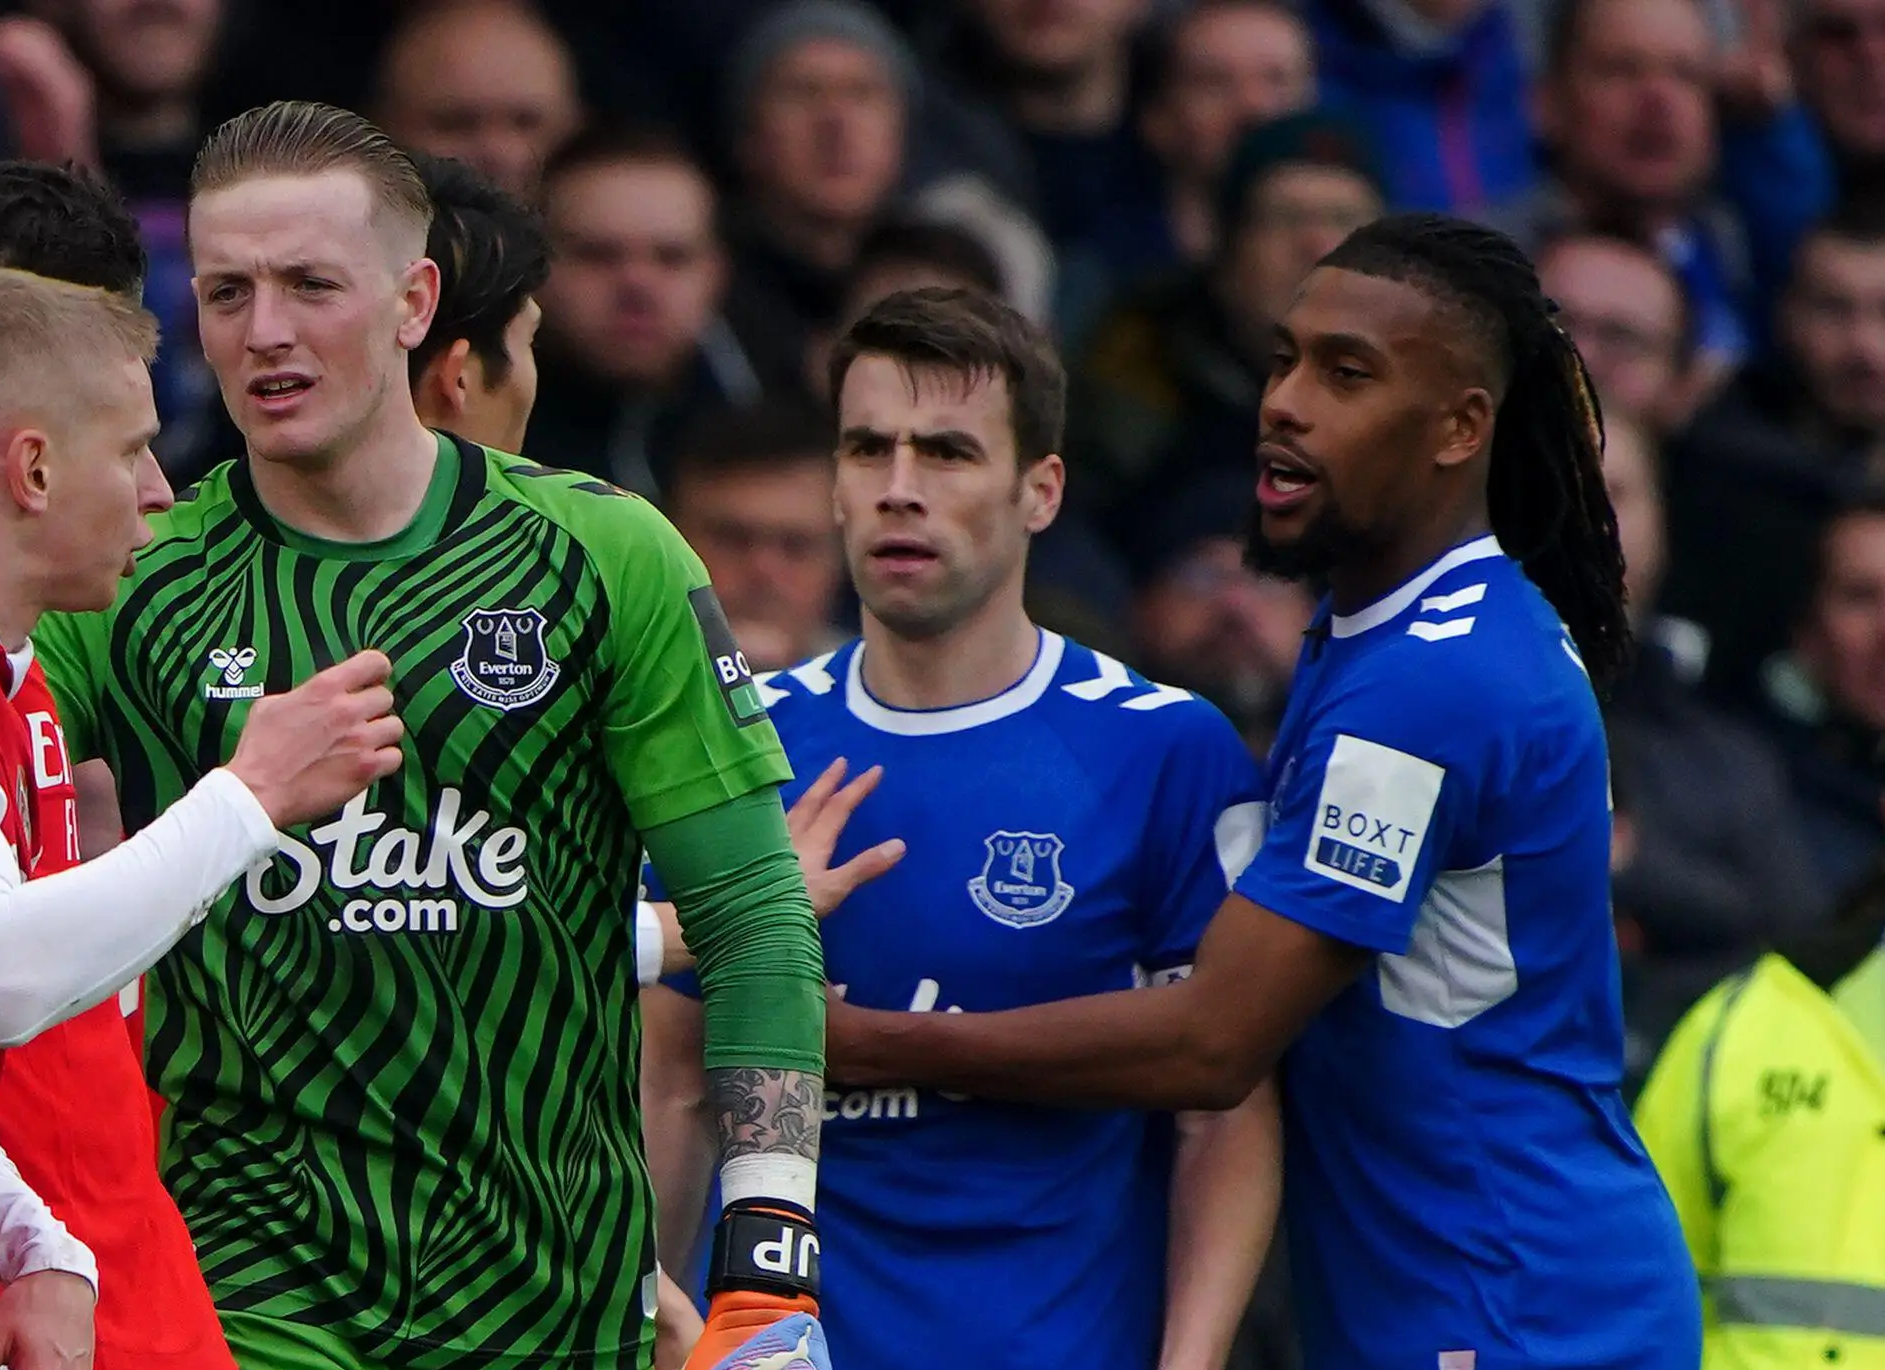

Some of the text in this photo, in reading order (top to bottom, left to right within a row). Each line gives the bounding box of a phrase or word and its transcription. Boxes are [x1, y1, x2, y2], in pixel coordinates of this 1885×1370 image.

[479, 661, 533, 675] Everton
[716, 650, 752, 684] BO
[205, 682, 265, 699] hummel
[1323, 804, 1416, 853] BOXT
[1329, 843, 1387, 883] LIFE
[327, 899, 458, 932] .com
